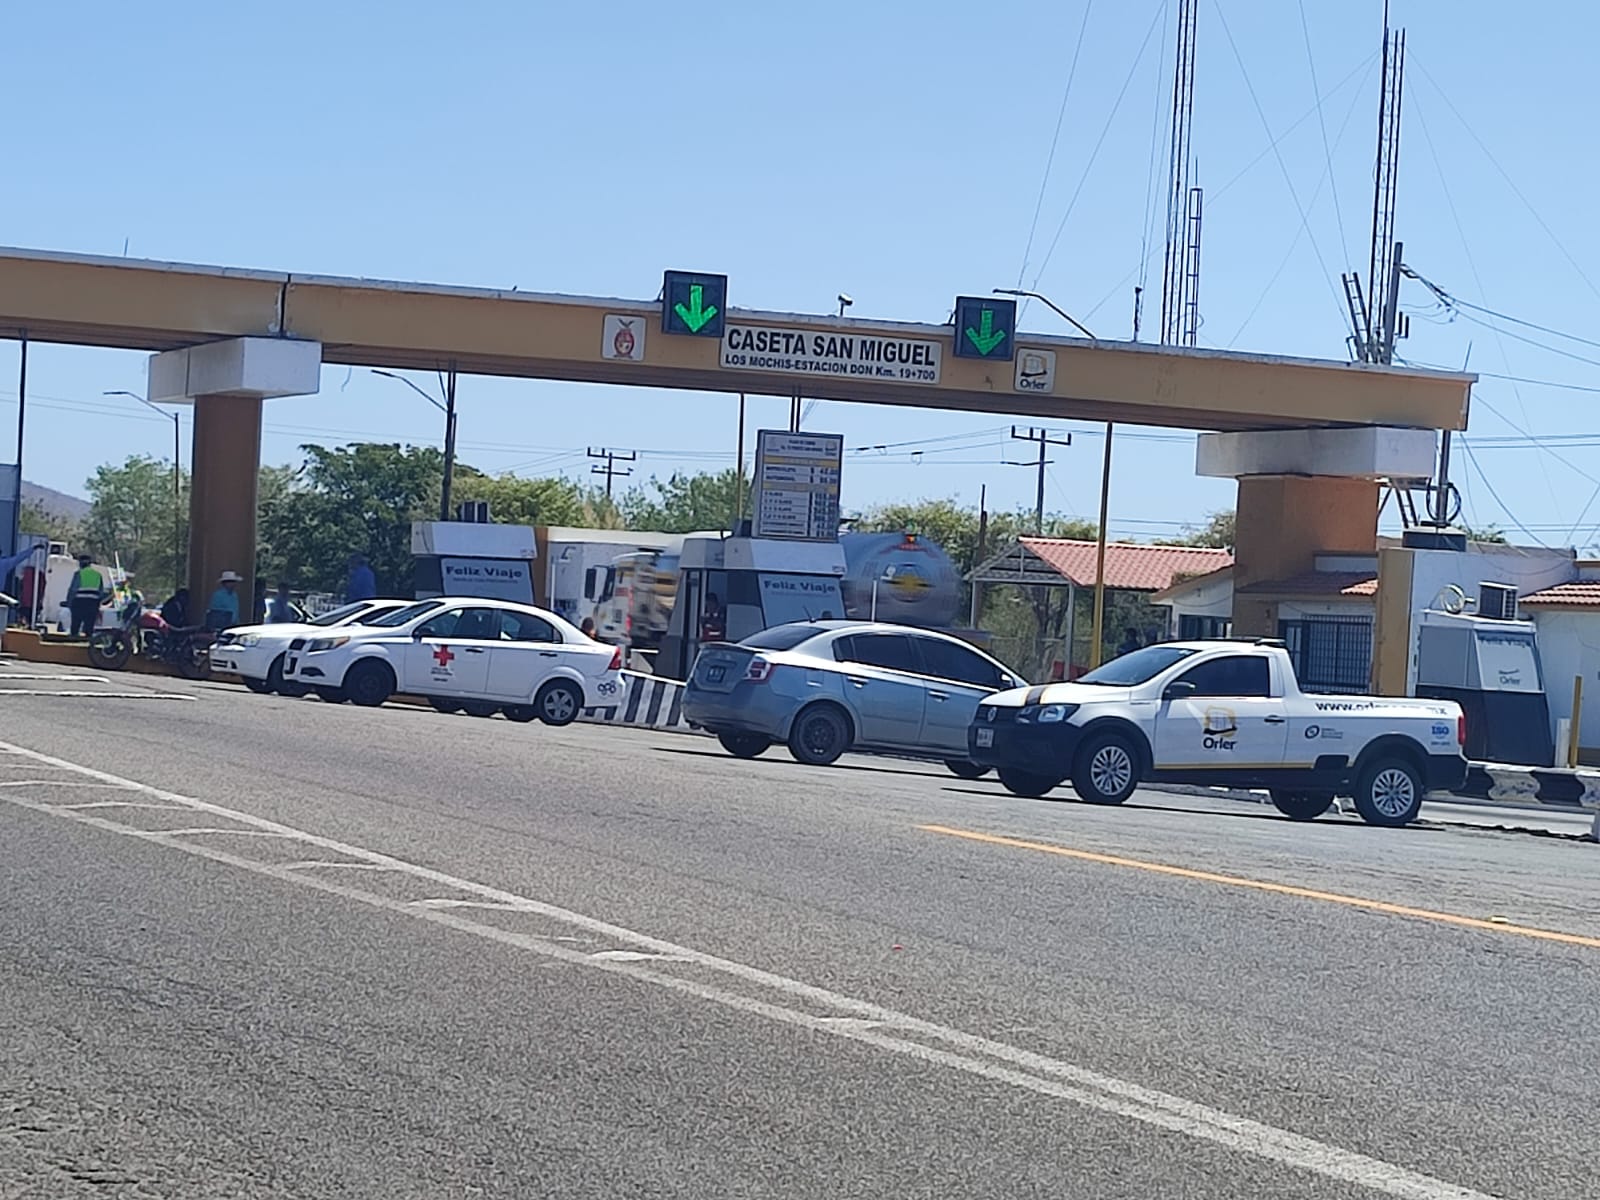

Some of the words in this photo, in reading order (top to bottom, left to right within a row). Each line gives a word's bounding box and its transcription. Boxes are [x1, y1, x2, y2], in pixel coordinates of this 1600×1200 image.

[728, 328, 806, 355] CASETA
[812, 335, 853, 359] SAN
[859, 340, 936, 366] MIGUEL
[725, 353, 746, 366] LOS
[749, 355, 847, 374] MOCHIS-ESTACION
[850, 364, 873, 376] DON
[875, 366, 896, 377] Km.
[446, 566, 480, 576] Feliz
[484, 567, 522, 579] Viaje
[764, 580, 796, 590] Feliz
[800, 582, 836, 594] Viaje
[1431, 725, 1450, 735] ISO
[1203, 736, 1238, 750] Orler
